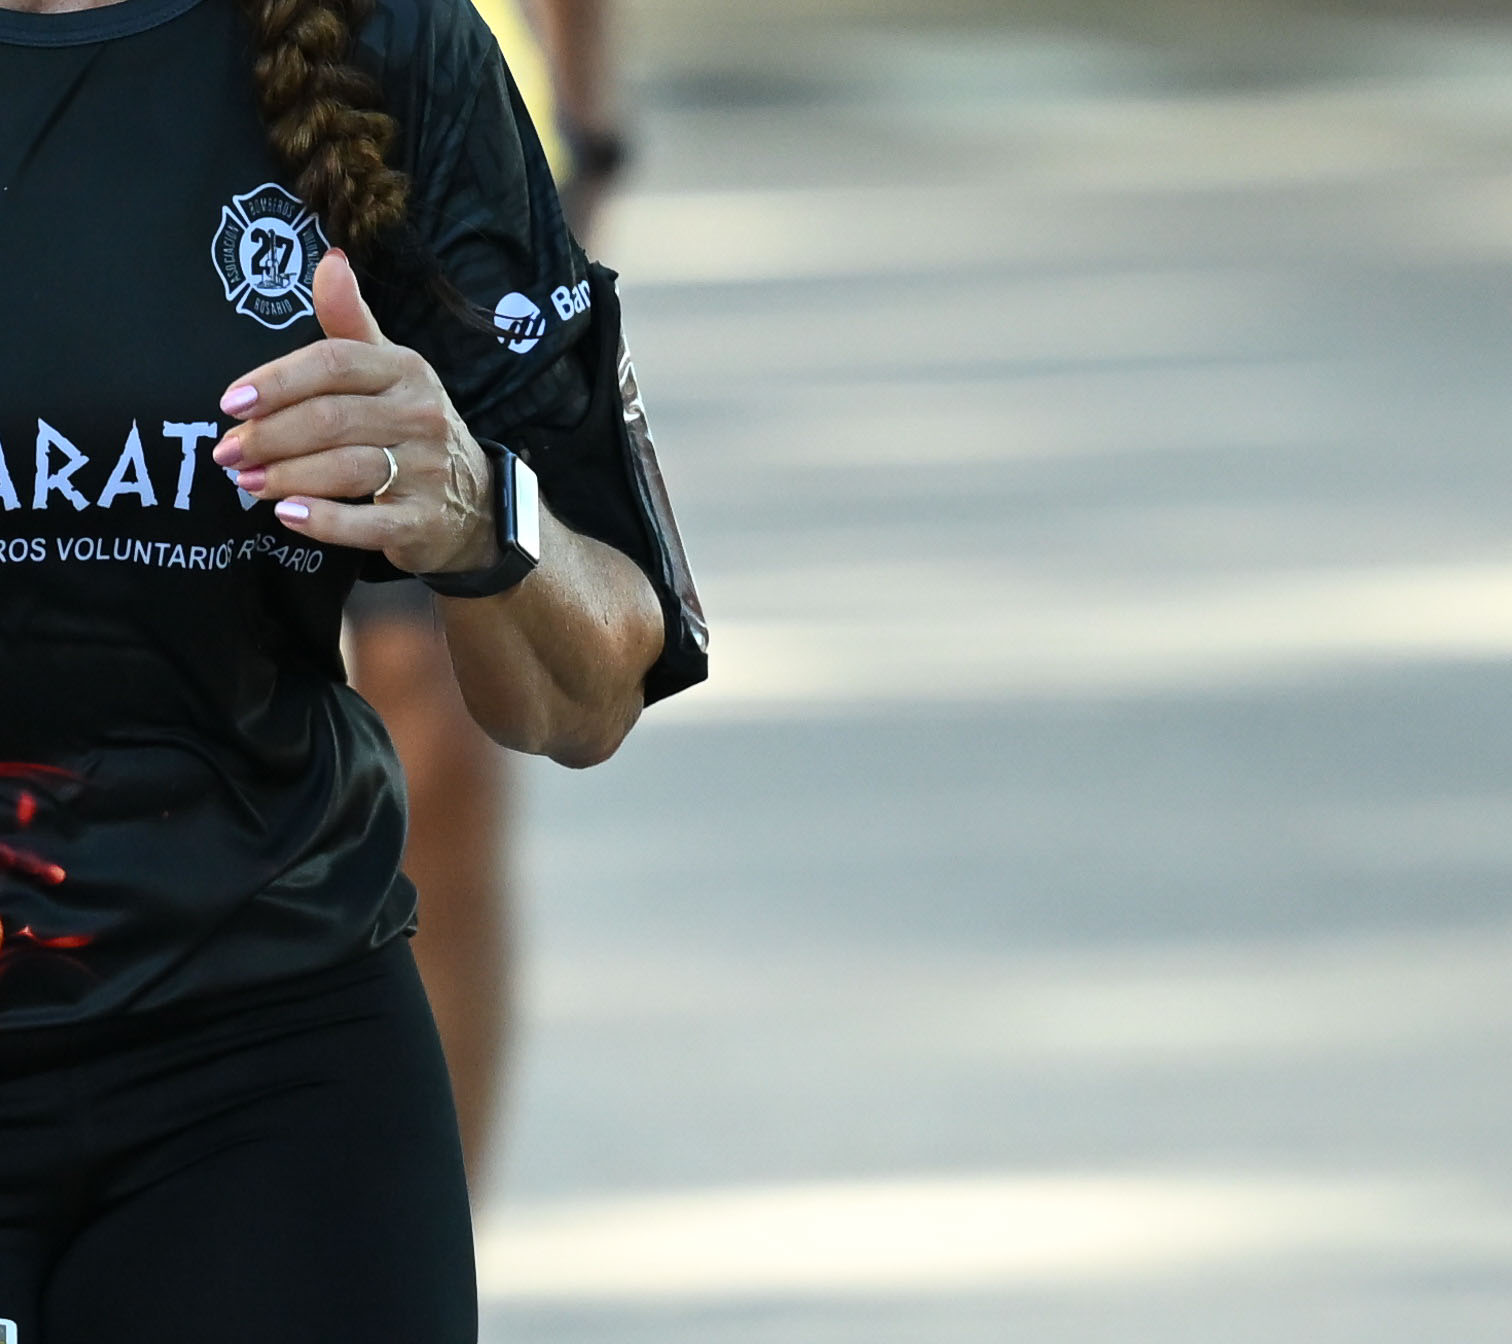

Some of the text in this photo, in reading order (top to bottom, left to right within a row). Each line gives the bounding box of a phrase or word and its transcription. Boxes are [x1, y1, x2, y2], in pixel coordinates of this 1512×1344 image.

[250, 227, 295, 279] 27
[253, 297, 293, 316] ROSARIO
[237, 533, 323, 573] RSARIO
